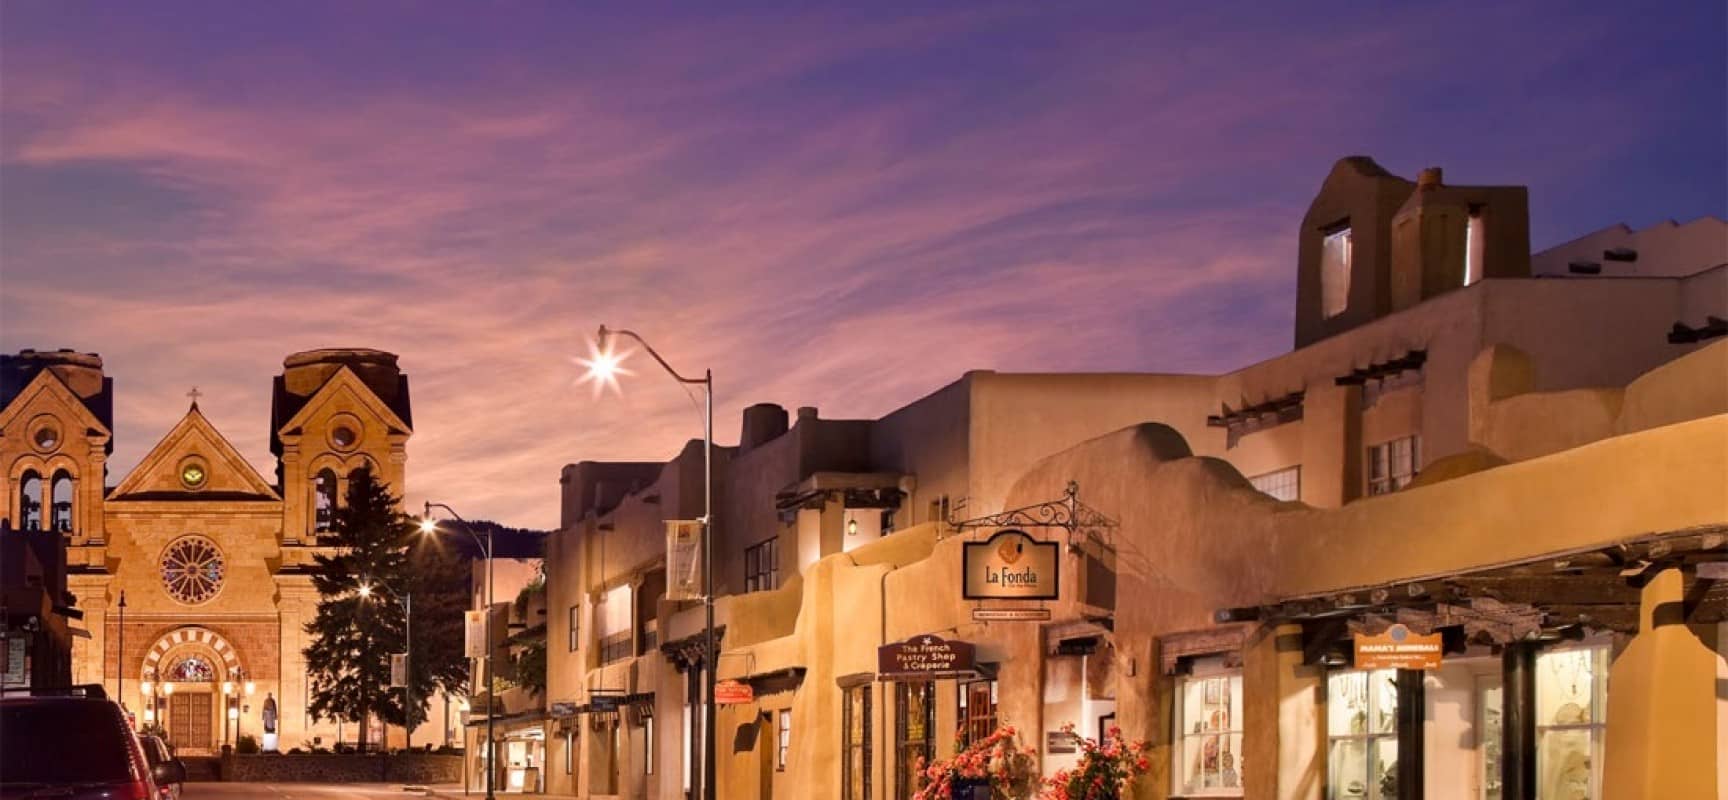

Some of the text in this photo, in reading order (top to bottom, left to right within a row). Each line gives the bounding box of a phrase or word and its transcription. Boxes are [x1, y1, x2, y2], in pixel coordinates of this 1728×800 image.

[986, 566, 1037, 587] La Fonda
[902, 644, 951, 653] The French
[896, 652, 956, 662] Pastry Shop
